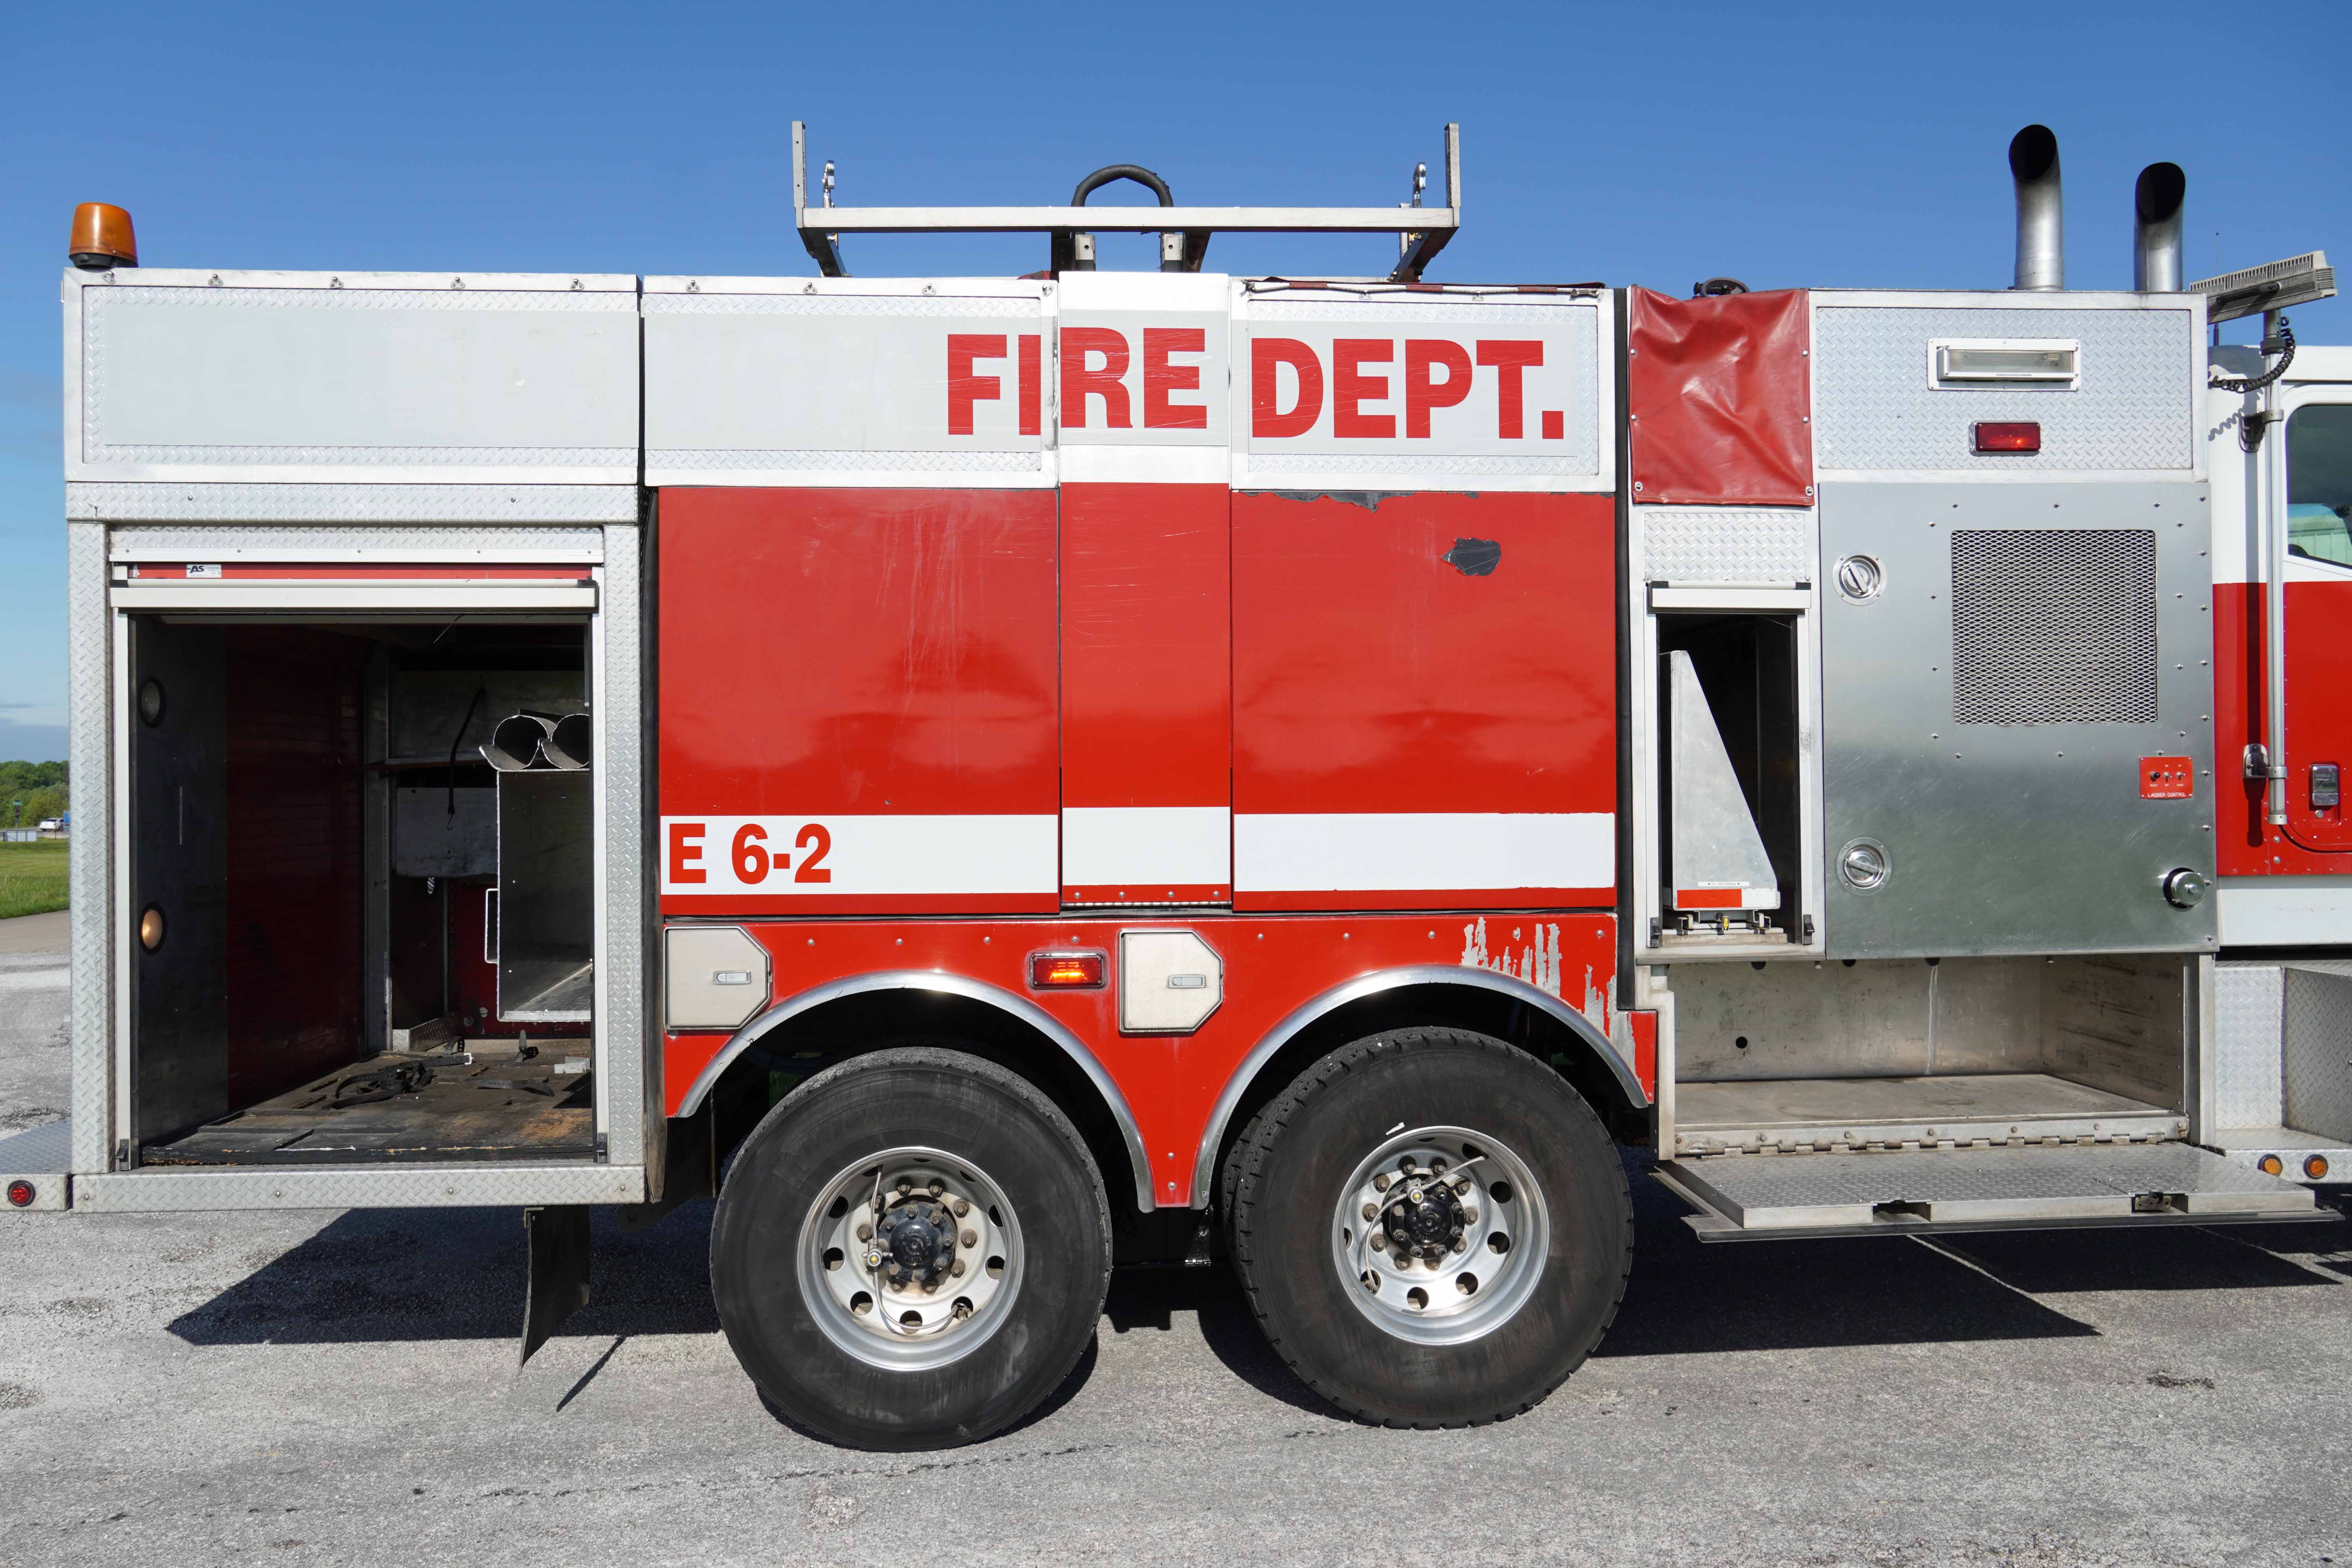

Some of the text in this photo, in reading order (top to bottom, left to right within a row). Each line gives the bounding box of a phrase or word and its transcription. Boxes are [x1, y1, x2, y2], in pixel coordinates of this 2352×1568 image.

[947, 327, 1564, 439] FIRE DEPT.
[670, 823, 831, 884] E 6-2
